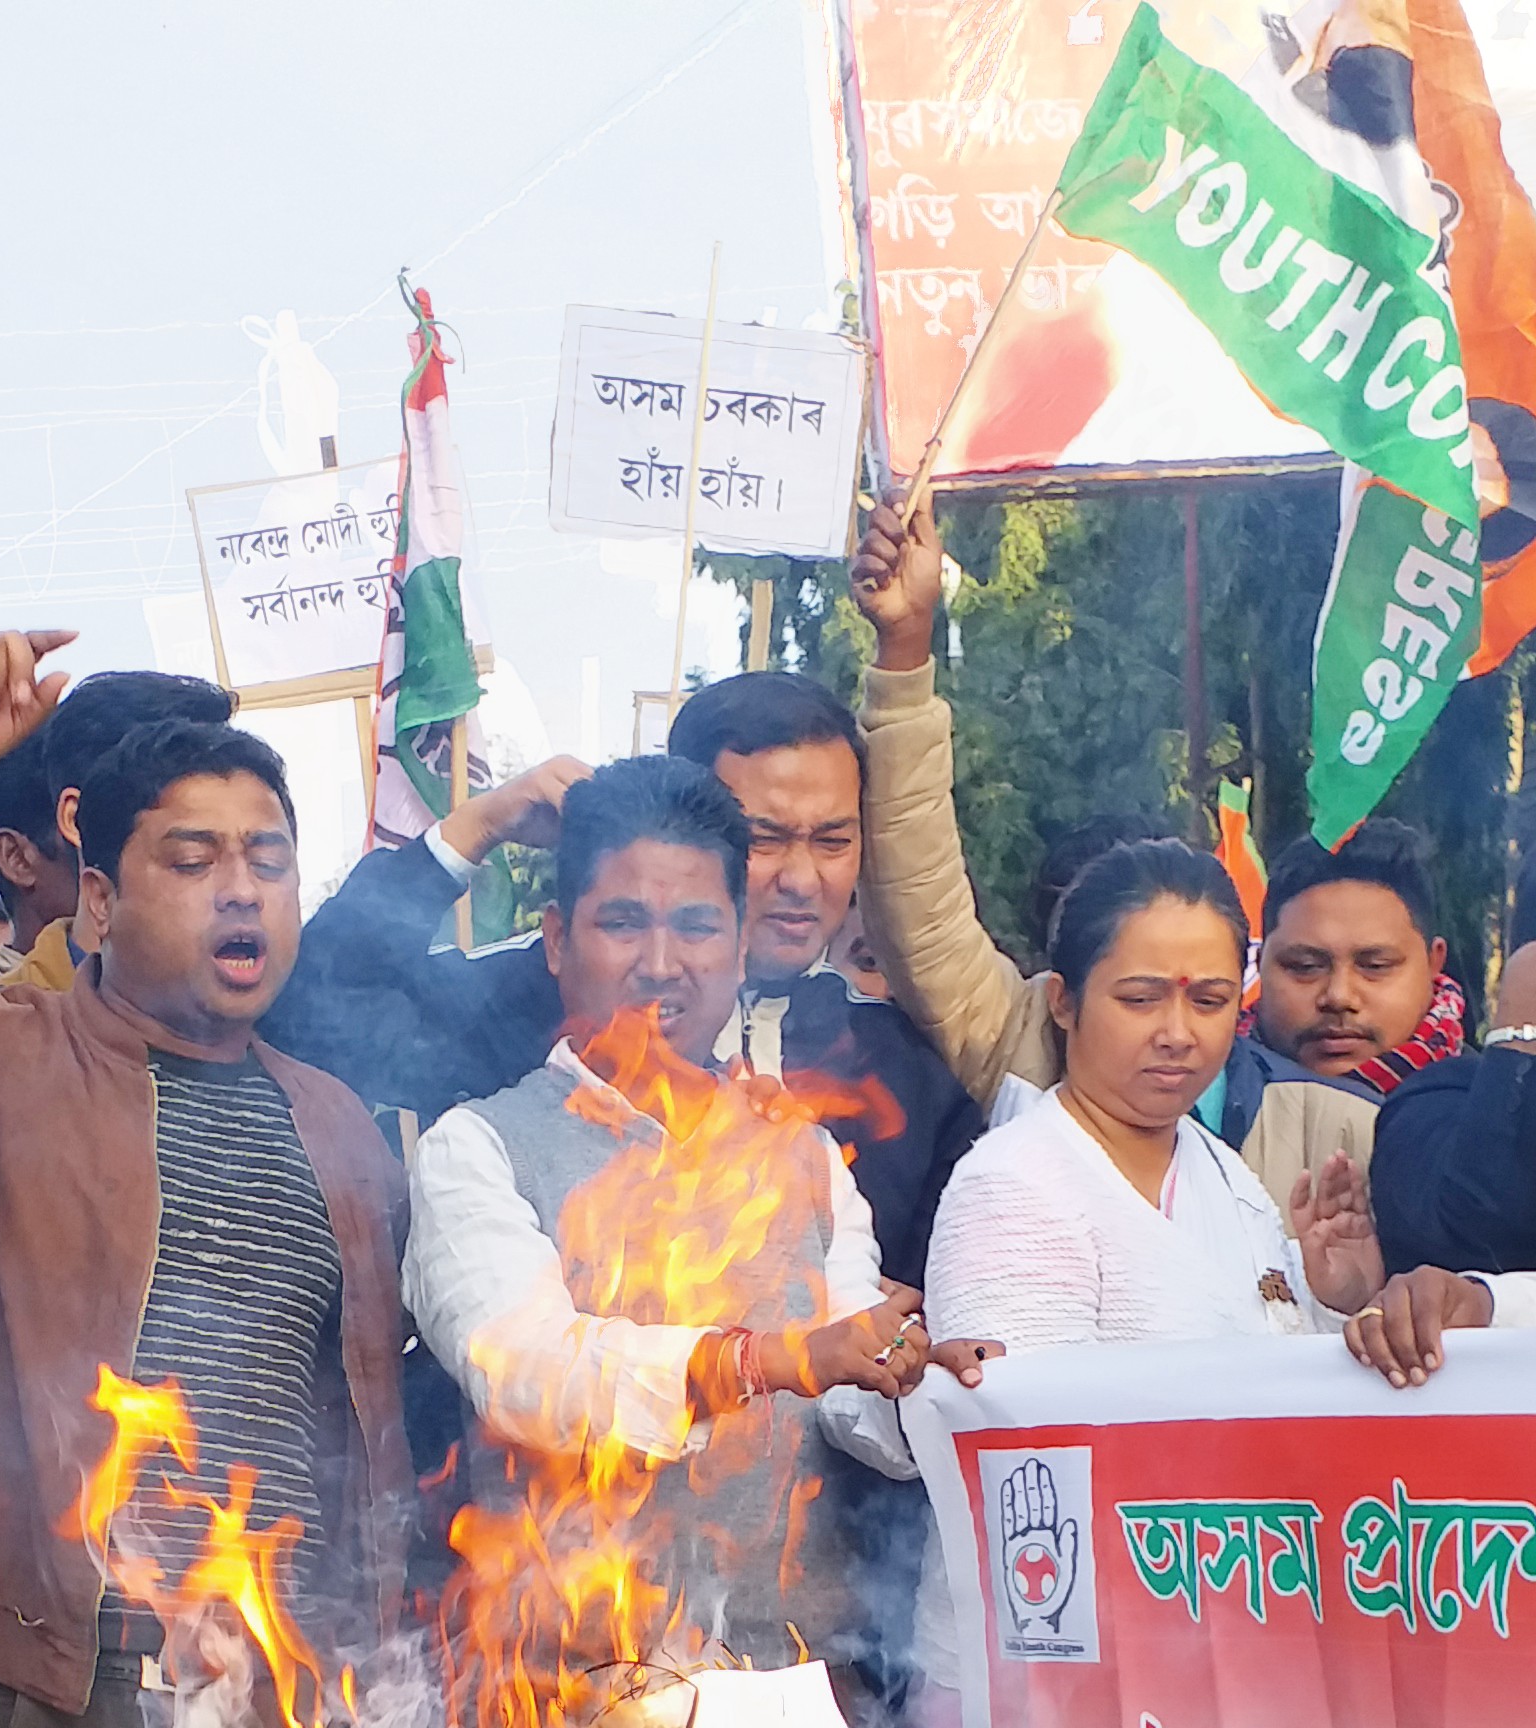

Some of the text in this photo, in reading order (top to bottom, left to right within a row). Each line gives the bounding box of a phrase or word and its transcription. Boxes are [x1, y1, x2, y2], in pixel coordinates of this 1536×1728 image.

[1128, 125, 1395, 383] YOUTH
[591, 373, 686, 421] অসম
[302, 502, 362, 554] মোদী
[1114, 1498, 1325, 1625] অসম
